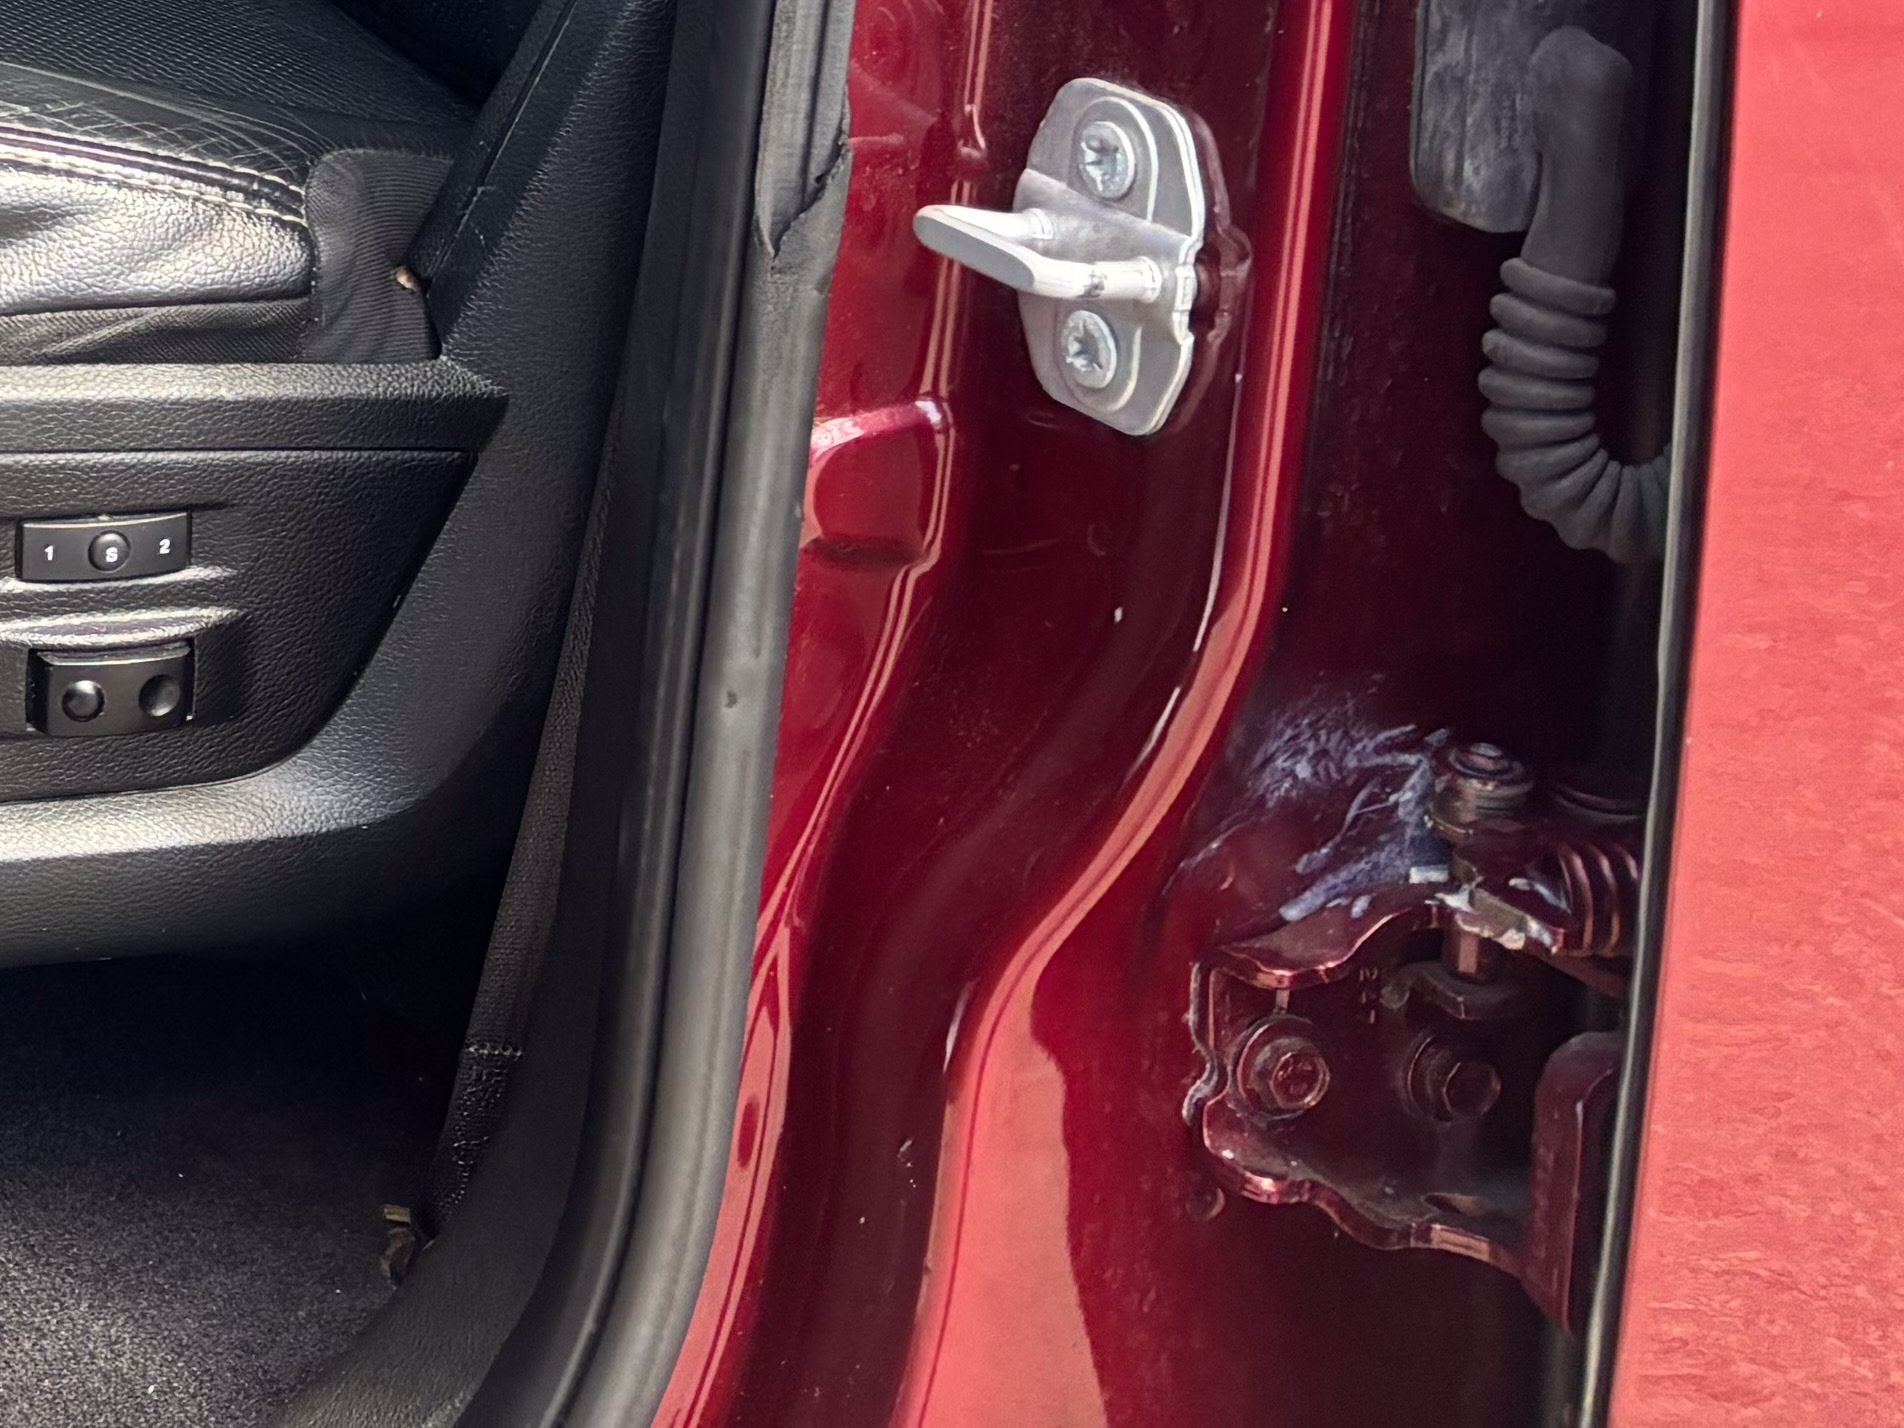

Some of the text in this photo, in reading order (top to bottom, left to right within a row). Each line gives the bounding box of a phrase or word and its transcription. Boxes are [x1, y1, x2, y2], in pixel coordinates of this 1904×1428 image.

[44, 539, 171, 563] 1 S 2
